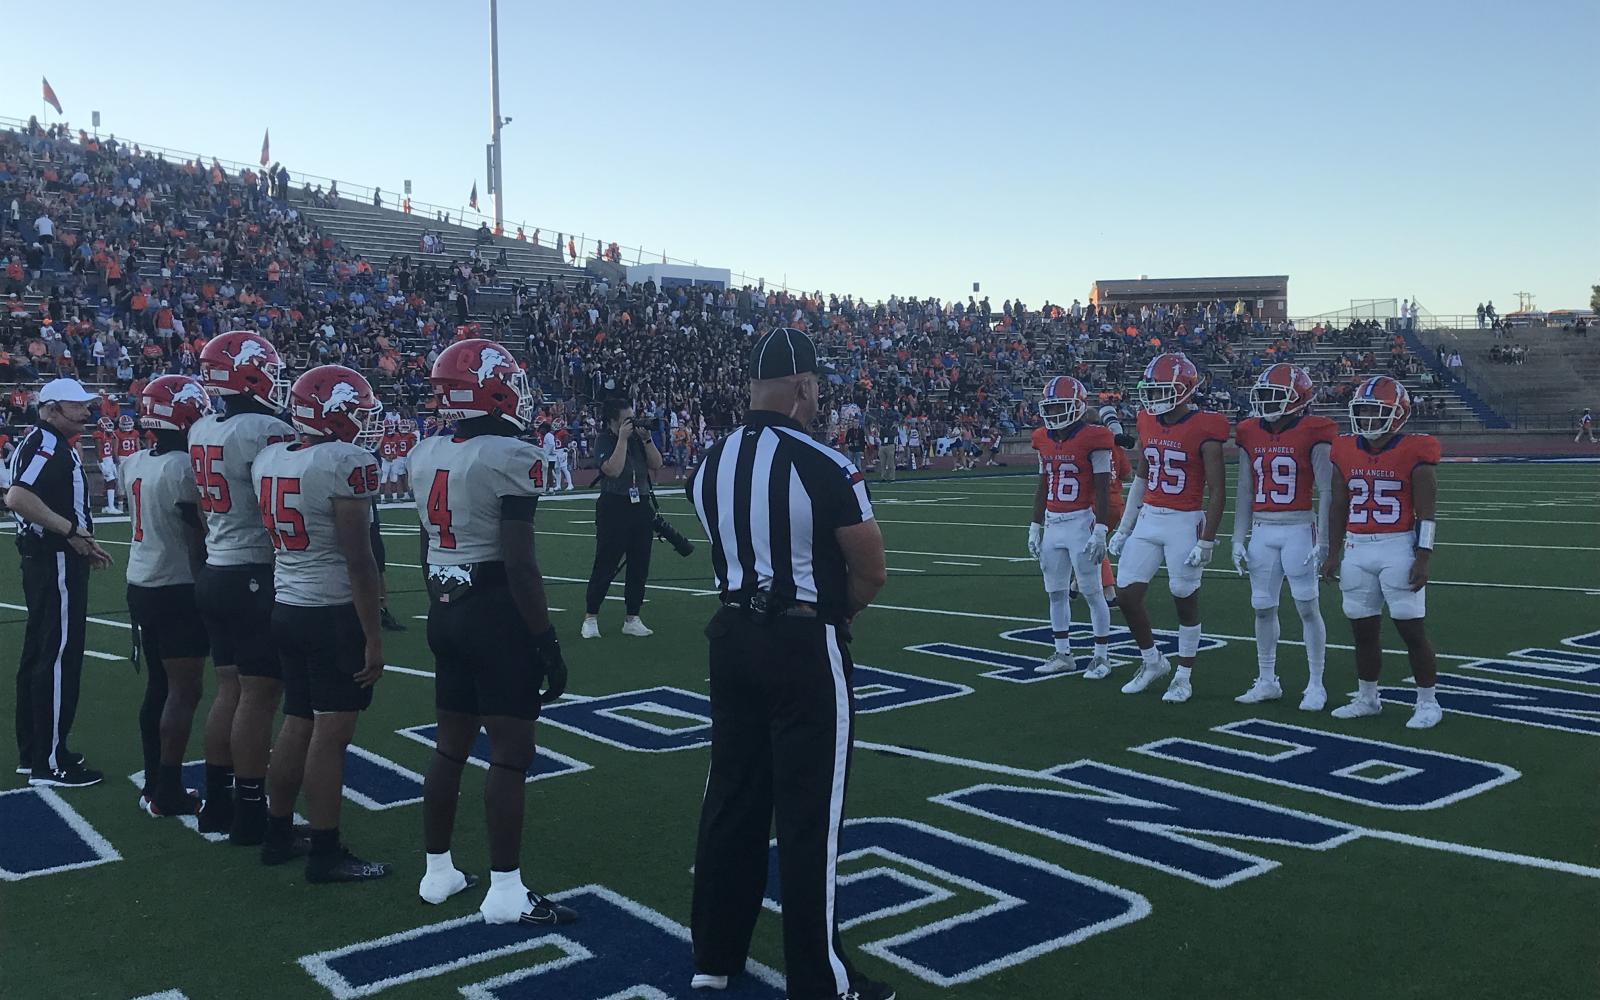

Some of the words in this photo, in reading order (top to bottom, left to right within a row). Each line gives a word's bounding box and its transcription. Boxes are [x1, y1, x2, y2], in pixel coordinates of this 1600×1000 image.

[190, 445, 232, 513] 95
[347, 464, 378, 495] 45
[528, 459, 544, 488] 4
[1045, 461, 1080, 502] 16
[1252, 455, 1298, 505] 19
[1350, 468, 1364, 476] SAN
[1366, 469, 1395, 478] ANGELO
[131, 477, 144, 542] 1
[259, 476, 310, 551] 45
[427, 469, 456, 549] 4
[1347, 478, 1403, 525] 25
